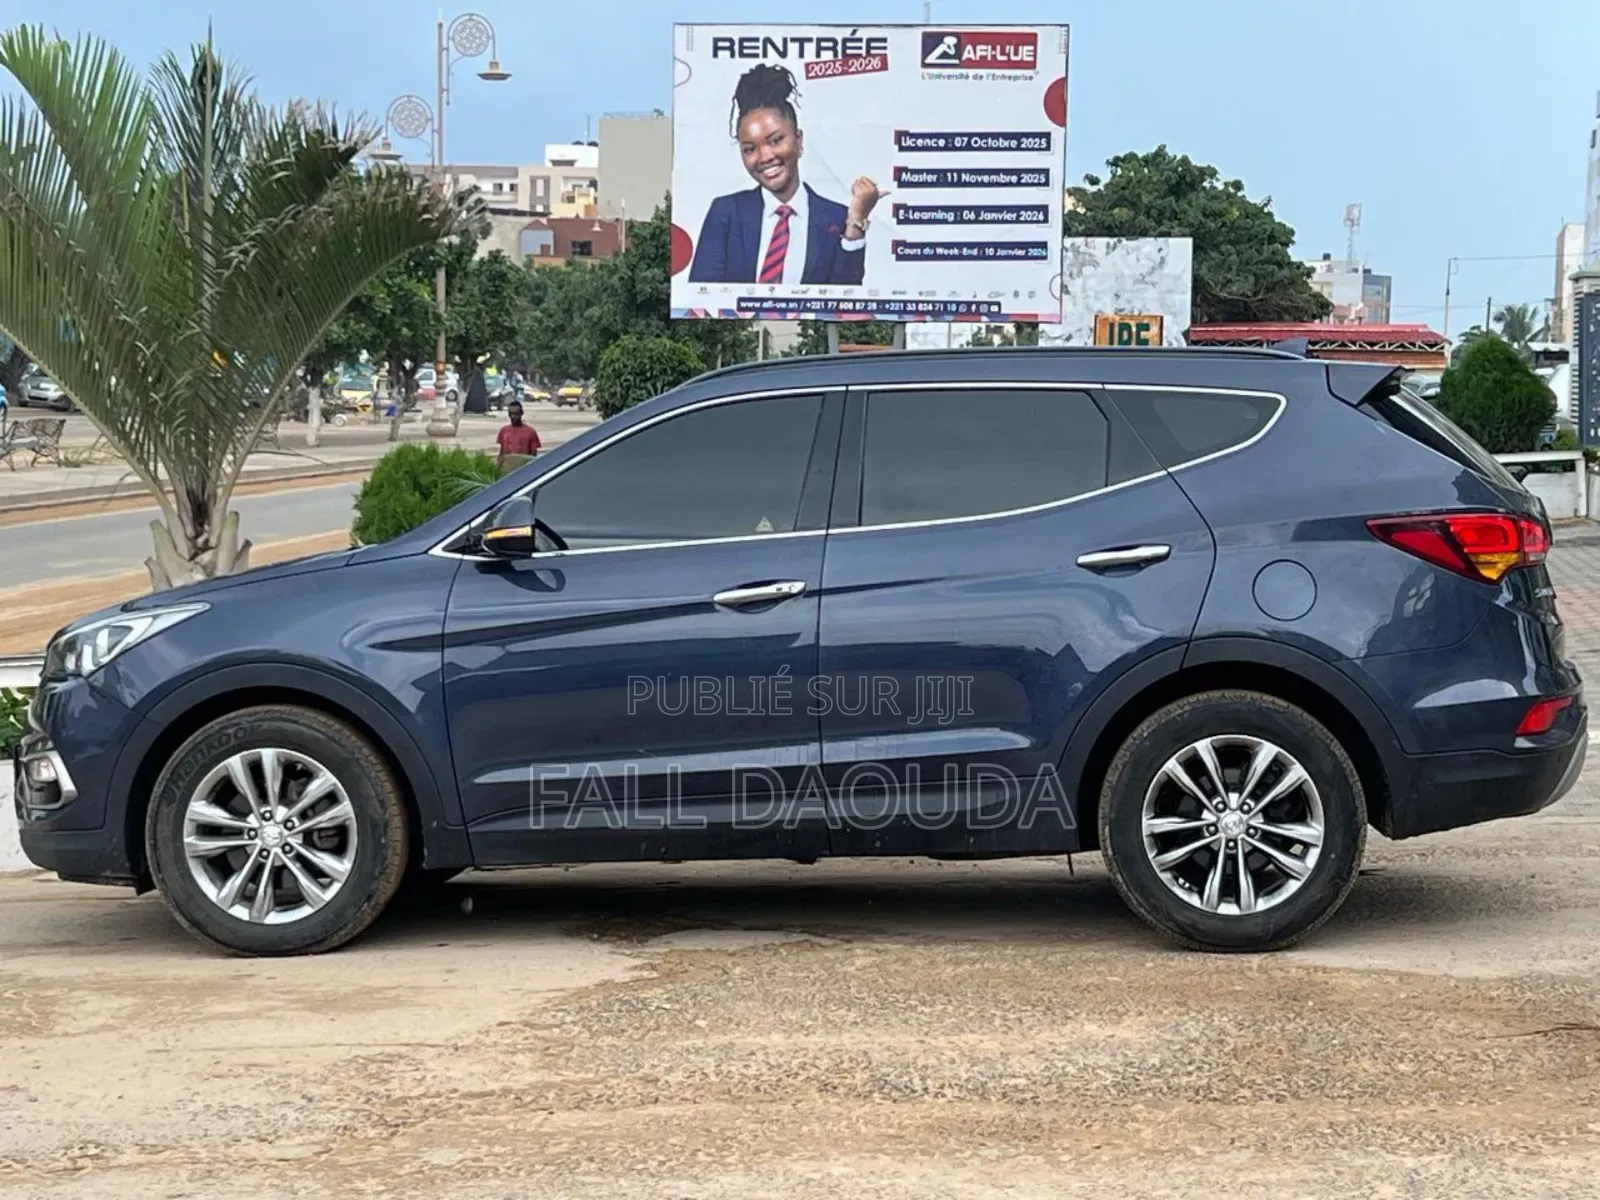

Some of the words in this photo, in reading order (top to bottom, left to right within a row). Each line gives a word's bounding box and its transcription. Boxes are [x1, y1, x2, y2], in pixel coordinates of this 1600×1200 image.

[712, 29, 888, 59] RENTRÉE
[808, 56, 881, 77] 2025-2026
[921, 72, 970, 81] L'Université
[972, 73, 984, 81] de
[901, 136, 946, 148] Licence
[954, 137, 968, 148] 07
[971, 137, 1017, 148] Octobre
[1020, 138, 1047, 148] 2025
[901, 172, 938, 182] Master
[946, 173, 957, 183] 11
[961, 172, 1018, 183] Novembre
[1020, 174, 1046, 183] 2025
[899, 209, 955, 222] E-Learning
[963, 210, 976, 221] 06
[978, 210, 1017, 221] Janvier
[1019, 210, 1044, 221] 2026
[897, 246, 921, 255] Cours
[923, 247, 934, 255] du
[985, 247, 994, 256] 10
[996, 247, 1026, 256] Janvier
